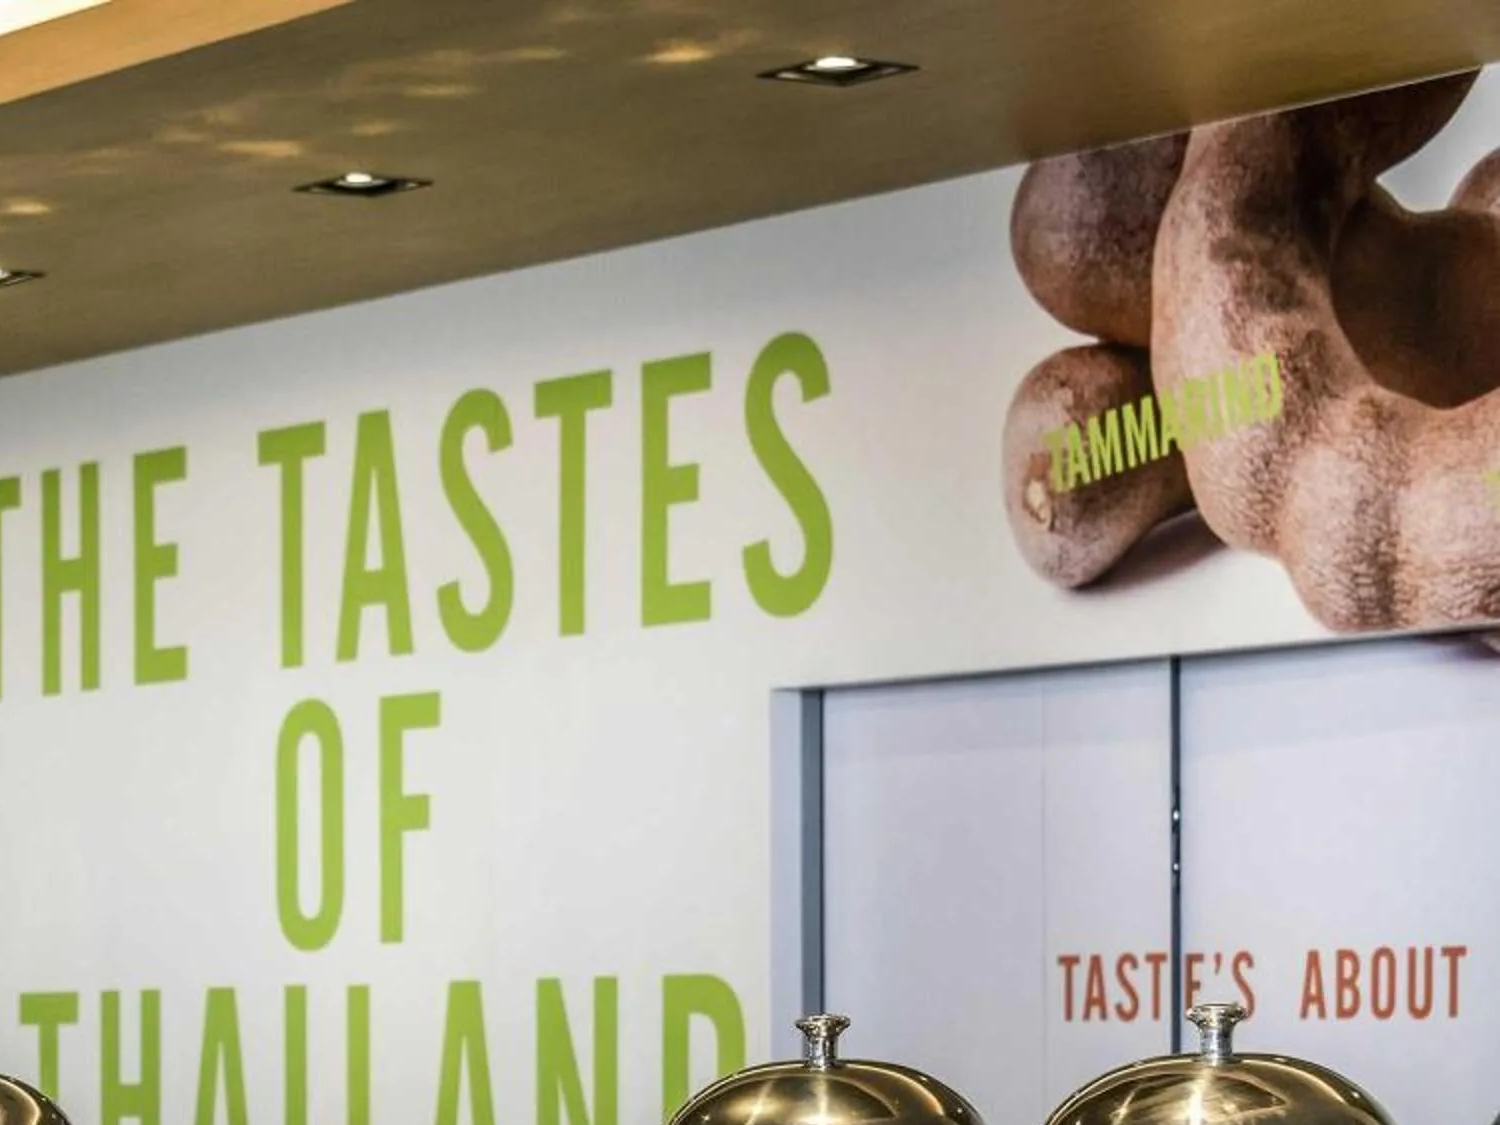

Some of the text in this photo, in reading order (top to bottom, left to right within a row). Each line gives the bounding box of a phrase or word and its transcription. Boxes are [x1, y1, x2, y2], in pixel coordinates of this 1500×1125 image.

[257, 331, 835, 669] TASTES
[275, 690, 442, 952] OF
[1056, 945, 1468, 1023] TASTE'S ABOUT
